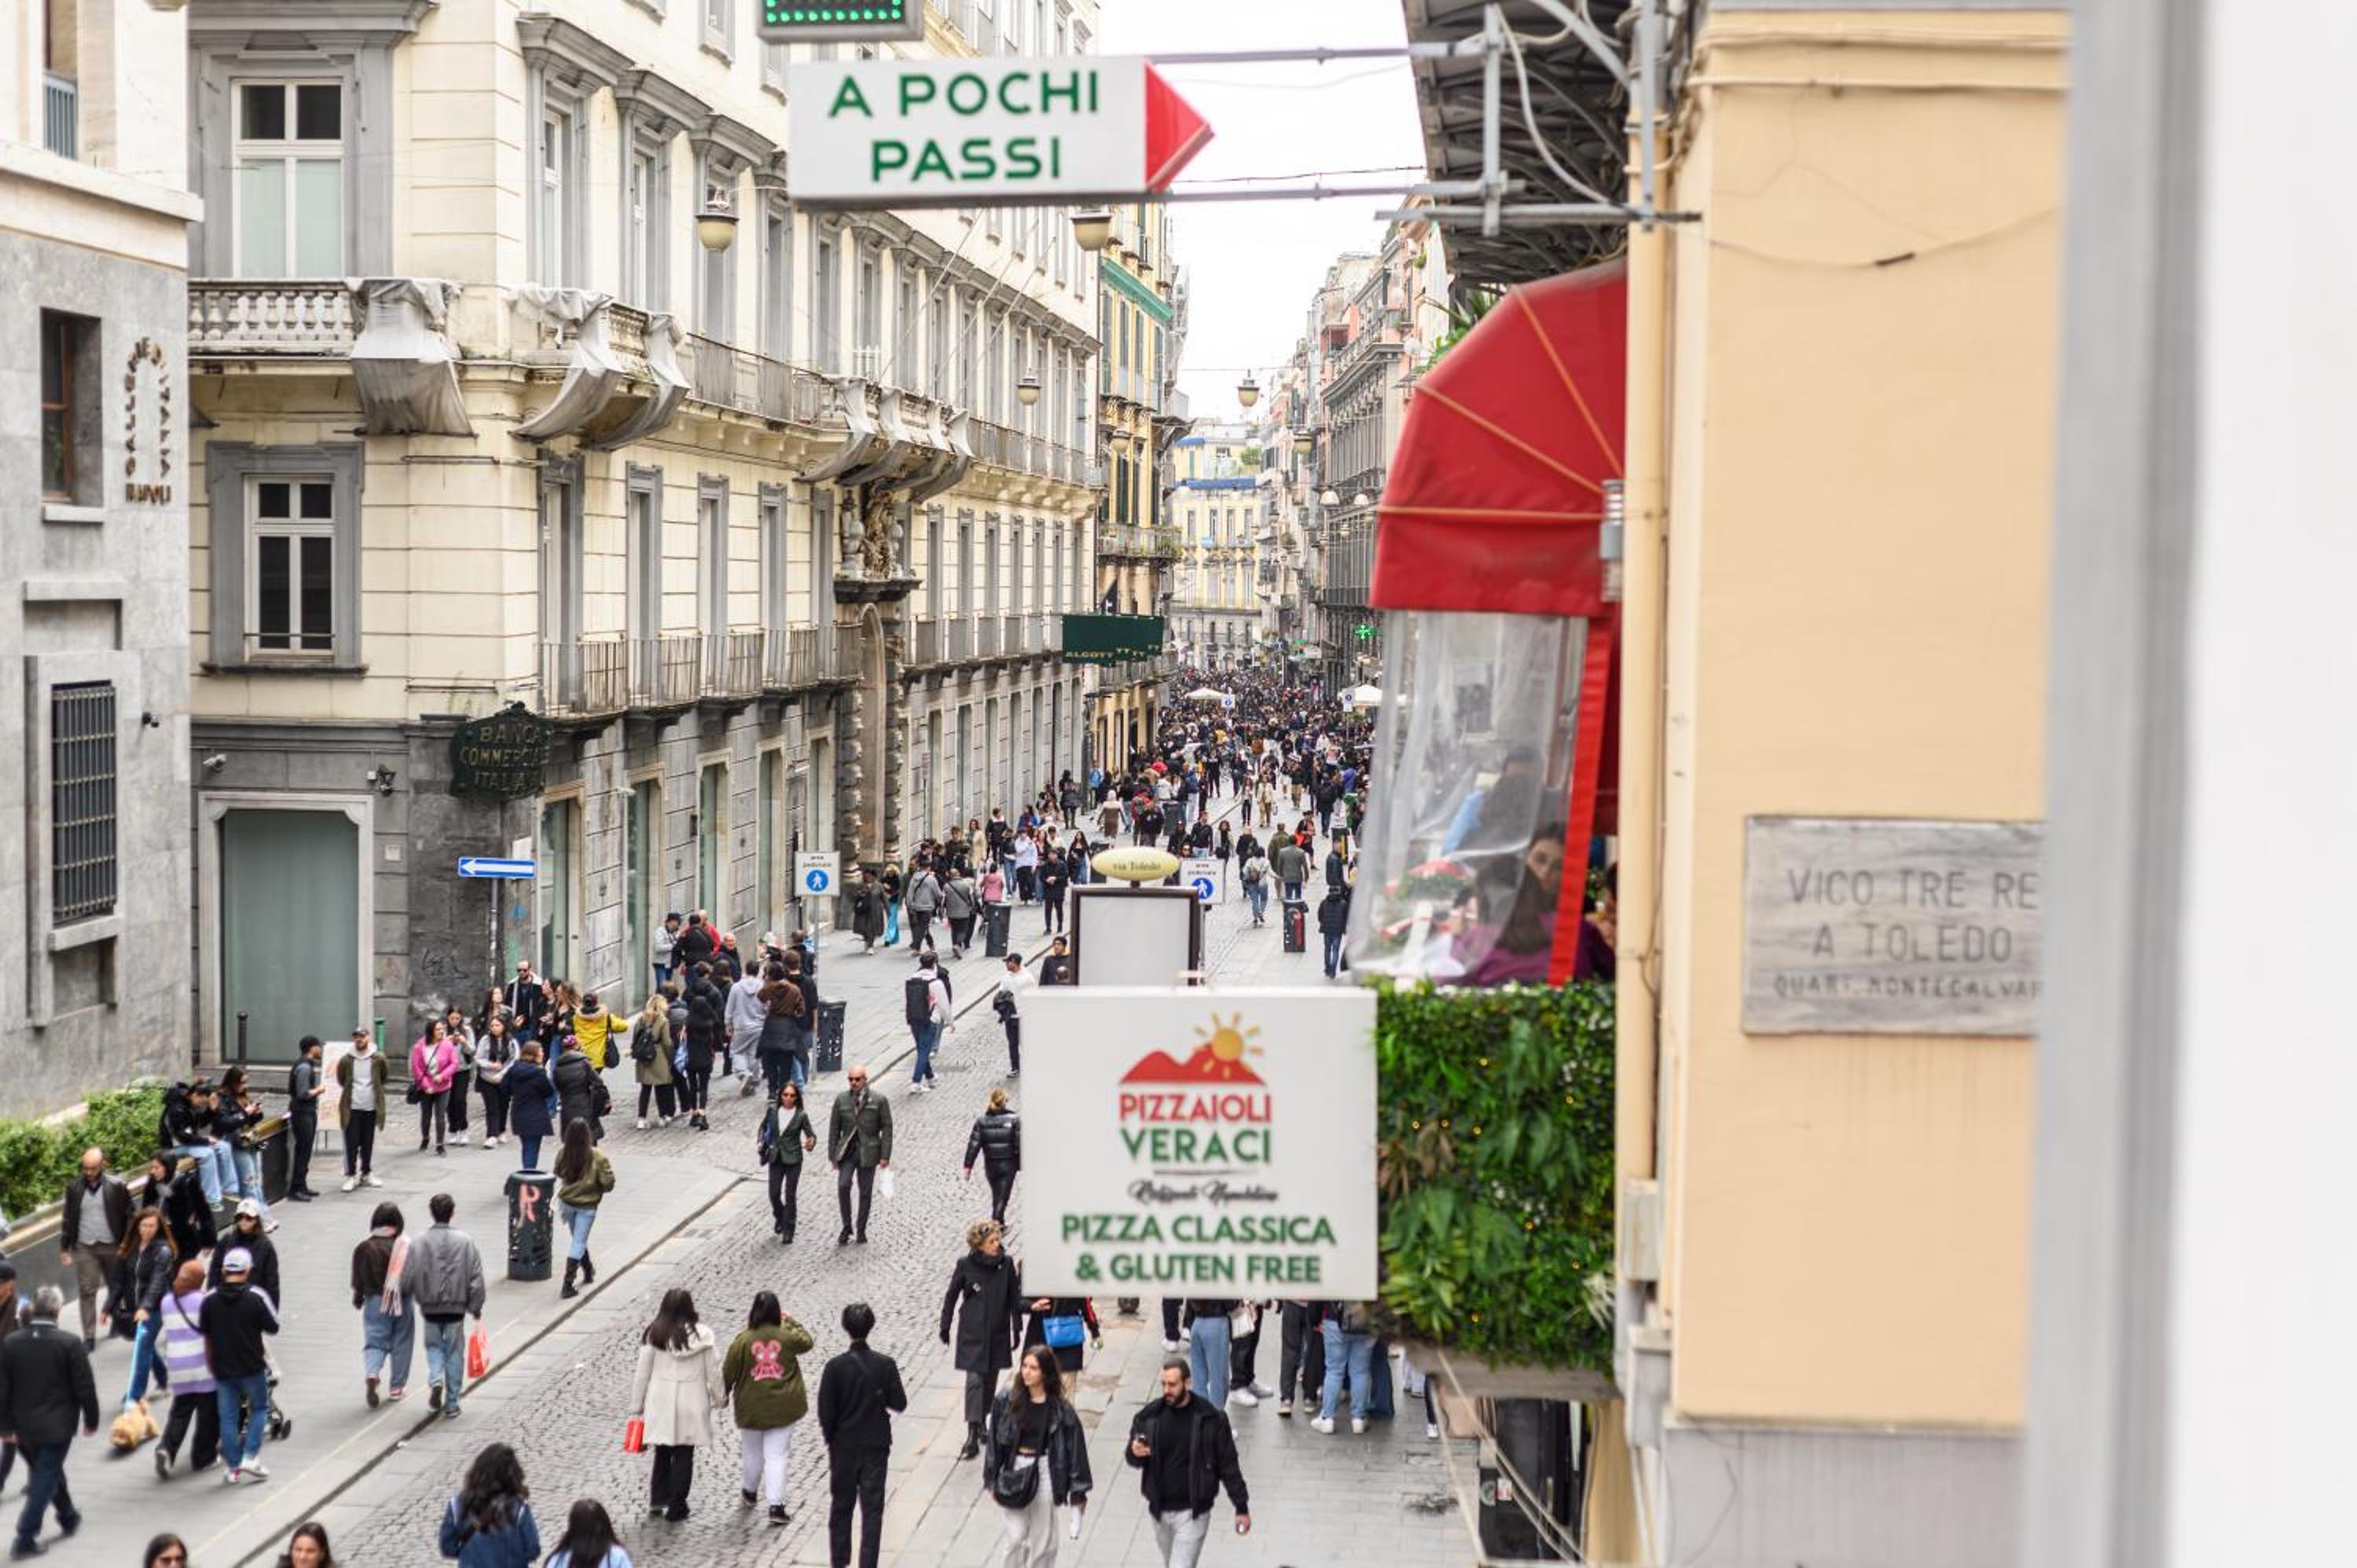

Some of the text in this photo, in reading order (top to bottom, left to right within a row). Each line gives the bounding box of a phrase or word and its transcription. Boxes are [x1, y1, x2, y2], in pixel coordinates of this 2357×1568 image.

[827, 70, 1098, 119] A POCHI
[871, 137, 1061, 182] PASSI
[479, 723, 541, 744] BANCA
[1787, 868, 2040, 910] VICO TRE RE
[1812, 923, 2013, 963] A TOLEDO
[1119, 1094, 1271, 1123] PIZZAIOLI
[1120, 1128, 1271, 1163] VERACI
[1062, 1214, 1336, 1246] PIZZA CLASSICA
[1075, 1254, 1321, 1283] & GLUTEN FREE
